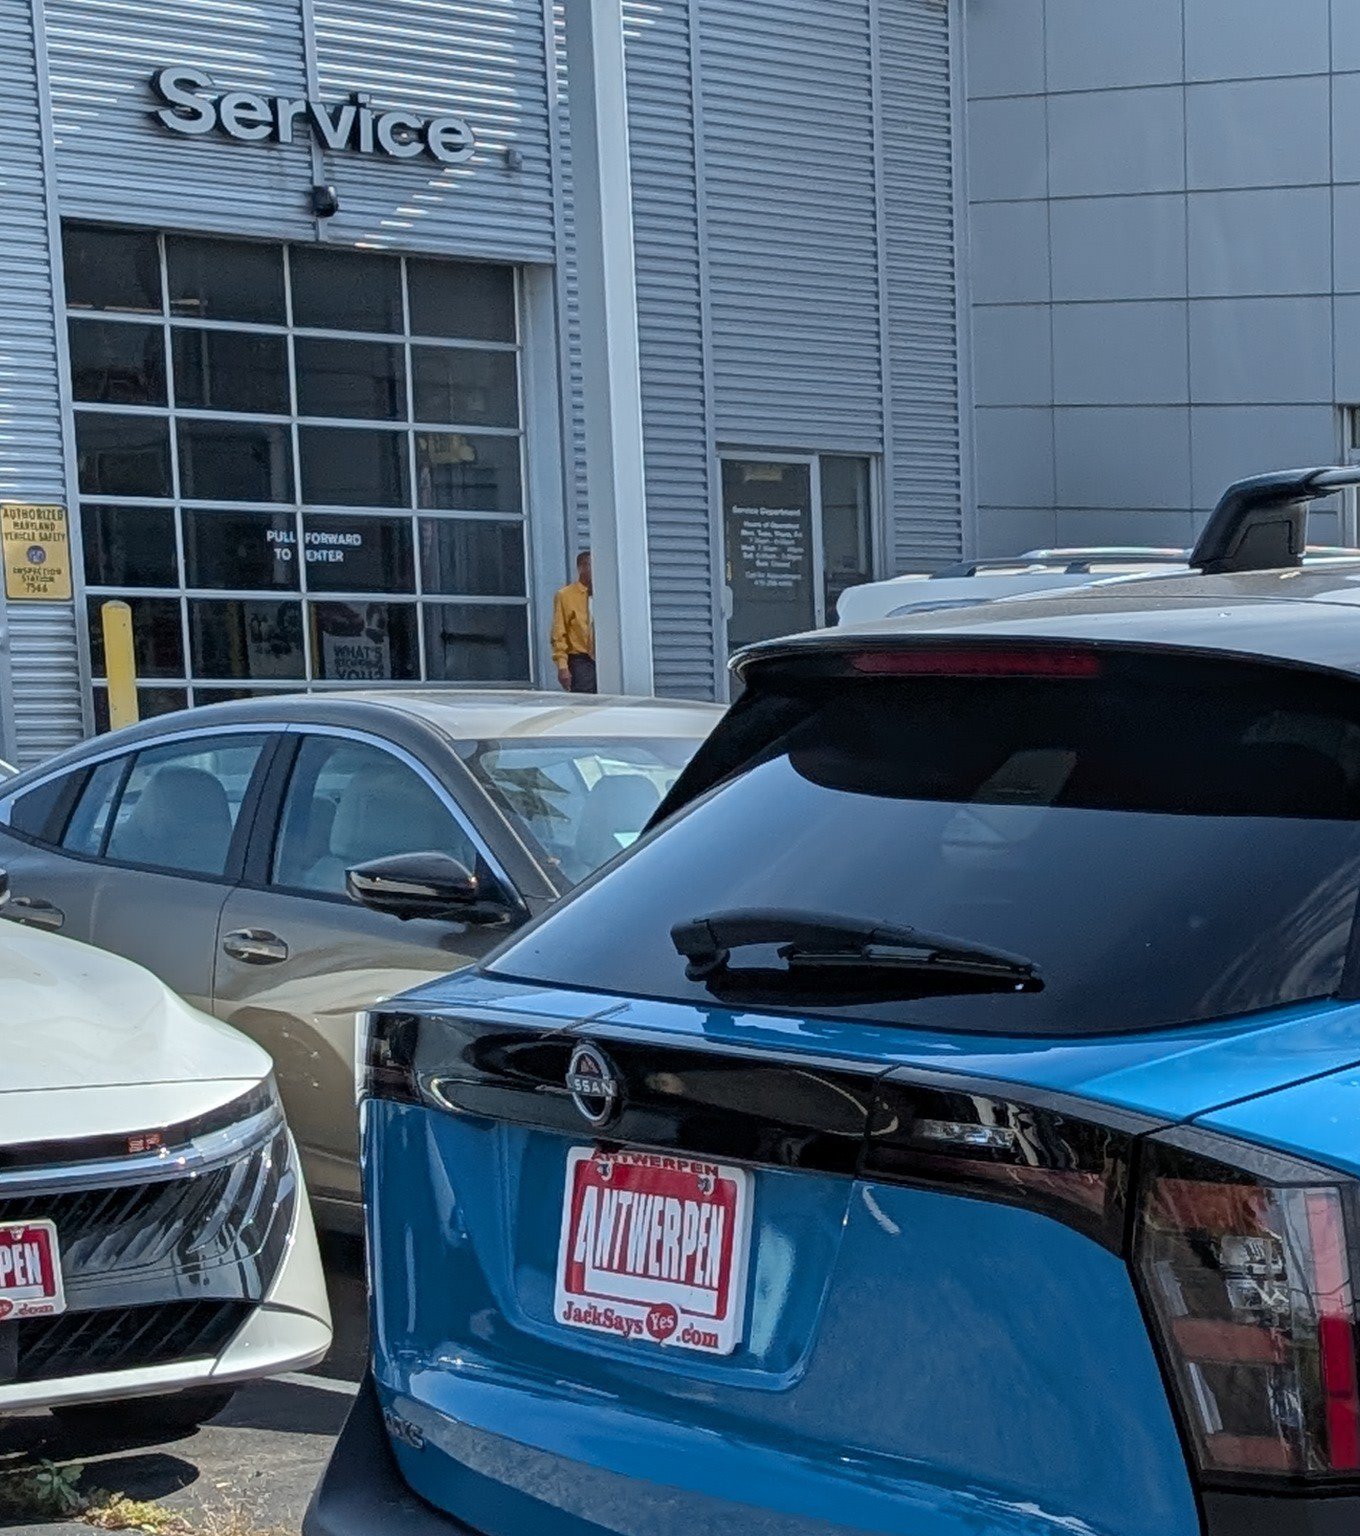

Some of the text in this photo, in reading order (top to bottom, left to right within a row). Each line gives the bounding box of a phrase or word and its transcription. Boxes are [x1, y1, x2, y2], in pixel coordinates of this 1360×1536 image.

[152, 66, 476, 163] Service
[267, 530, 362, 546] PULL FORWARD
[274, 548, 344, 562] TO ENTER
[573, 1185, 726, 1289] ANTWERPEN
